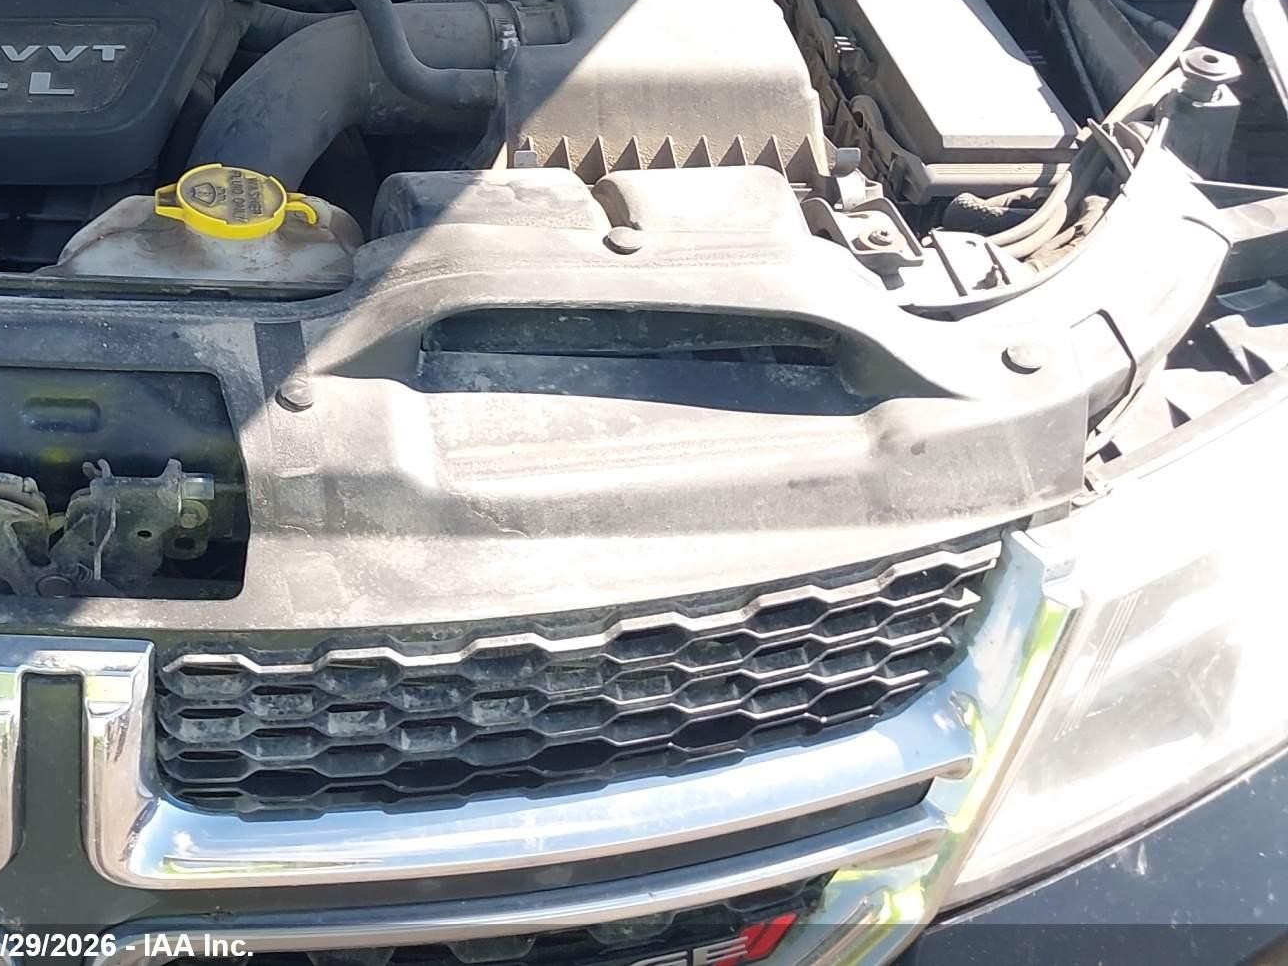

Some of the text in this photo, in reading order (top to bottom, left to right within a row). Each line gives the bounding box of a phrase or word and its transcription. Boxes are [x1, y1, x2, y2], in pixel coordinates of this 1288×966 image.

[0, 44, 126, 62] VVT
[230, 169, 248, 223] FLUID ONLY
[245, 174, 263, 216] WASHER
